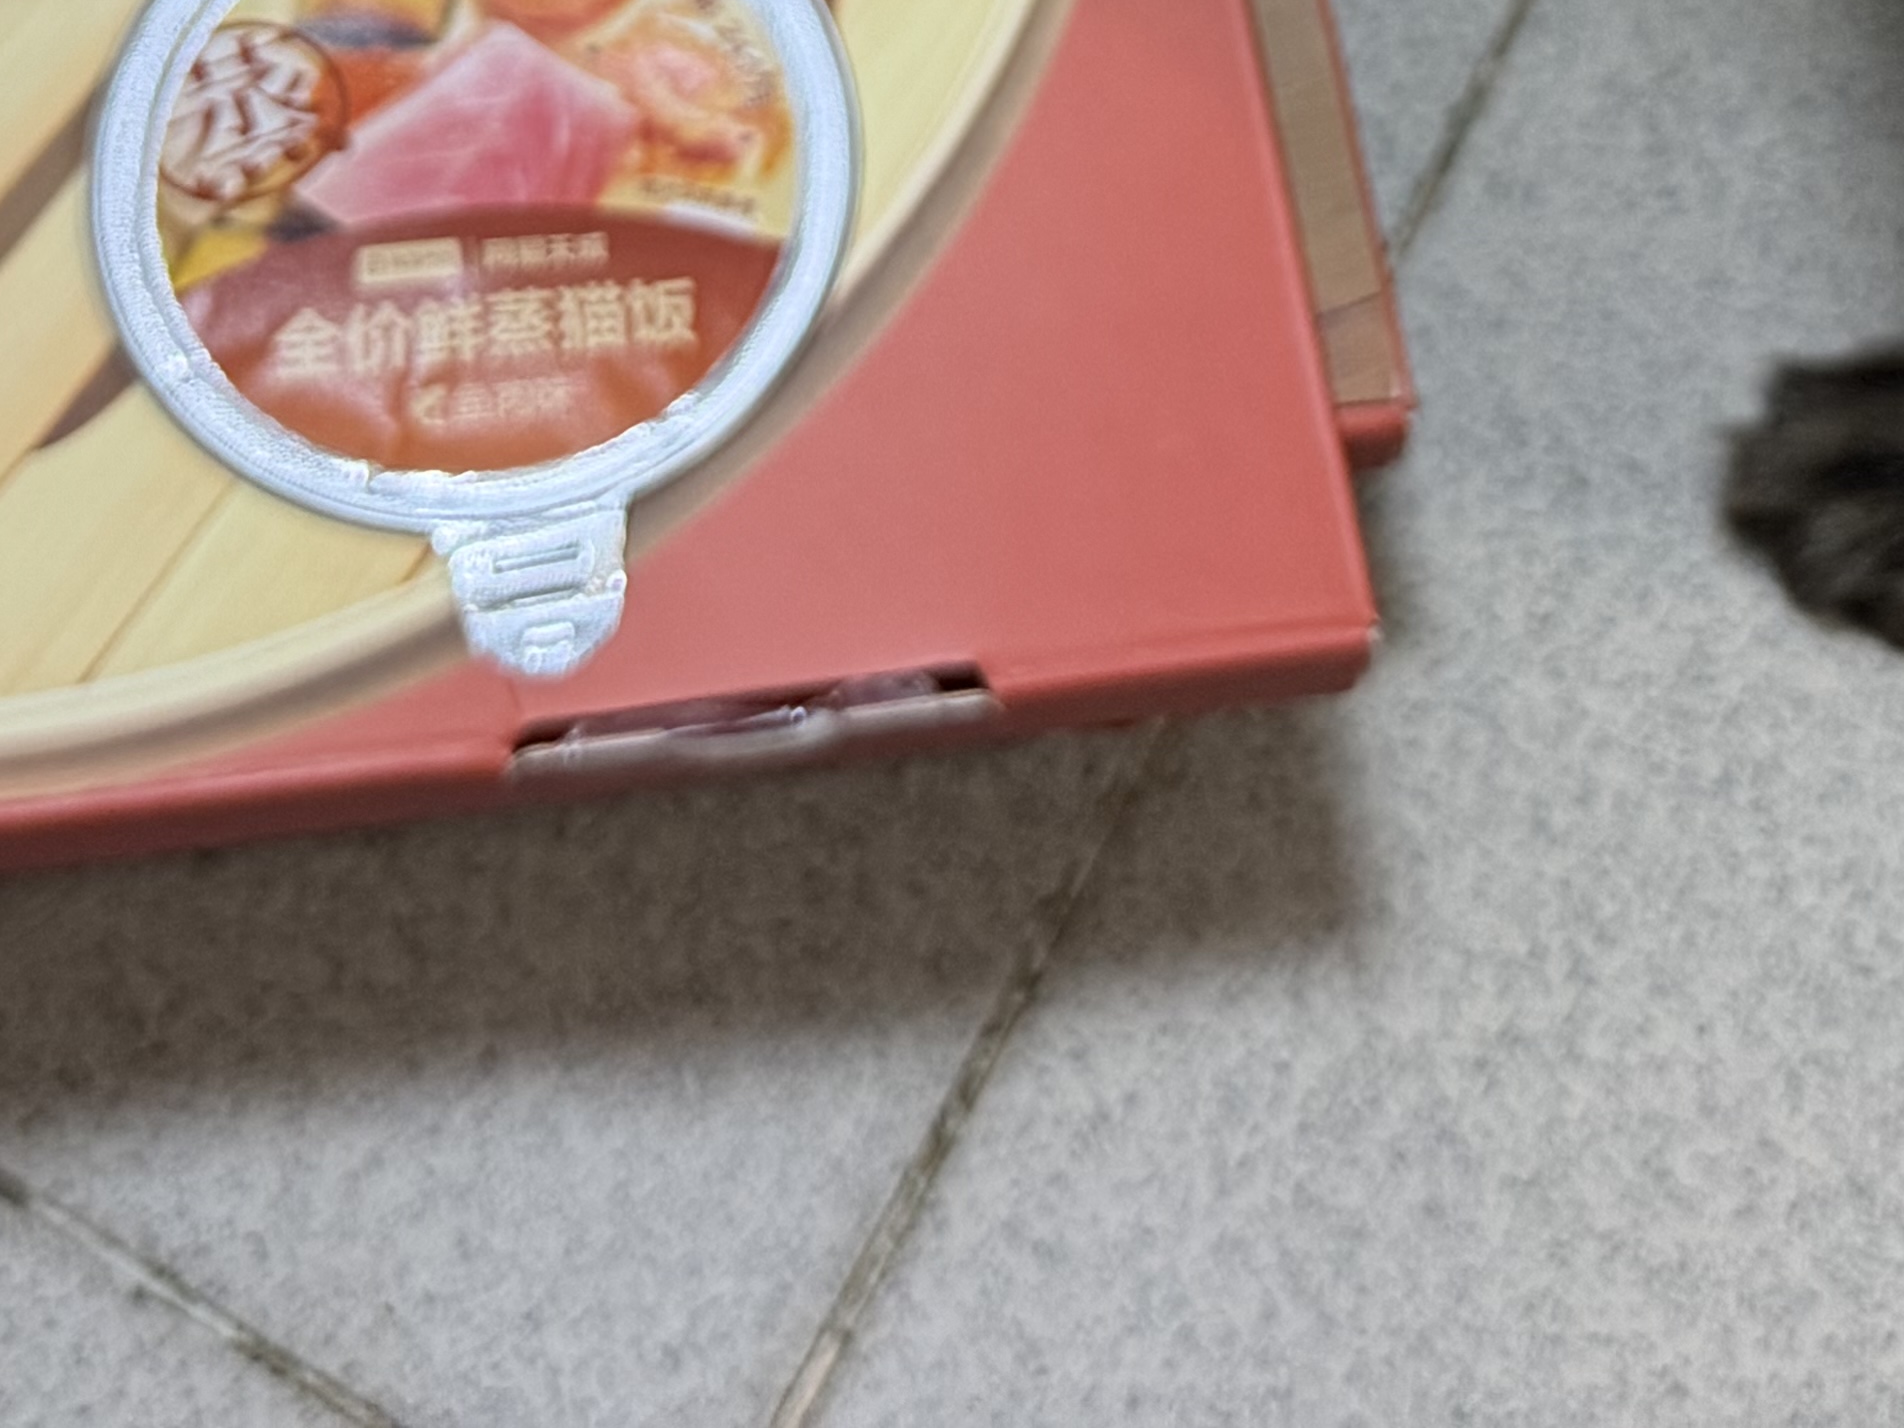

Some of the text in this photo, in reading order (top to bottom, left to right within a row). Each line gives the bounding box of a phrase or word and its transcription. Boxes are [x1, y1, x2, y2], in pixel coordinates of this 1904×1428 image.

[270, 276, 700, 384] 全价鲜蒸猫饭
